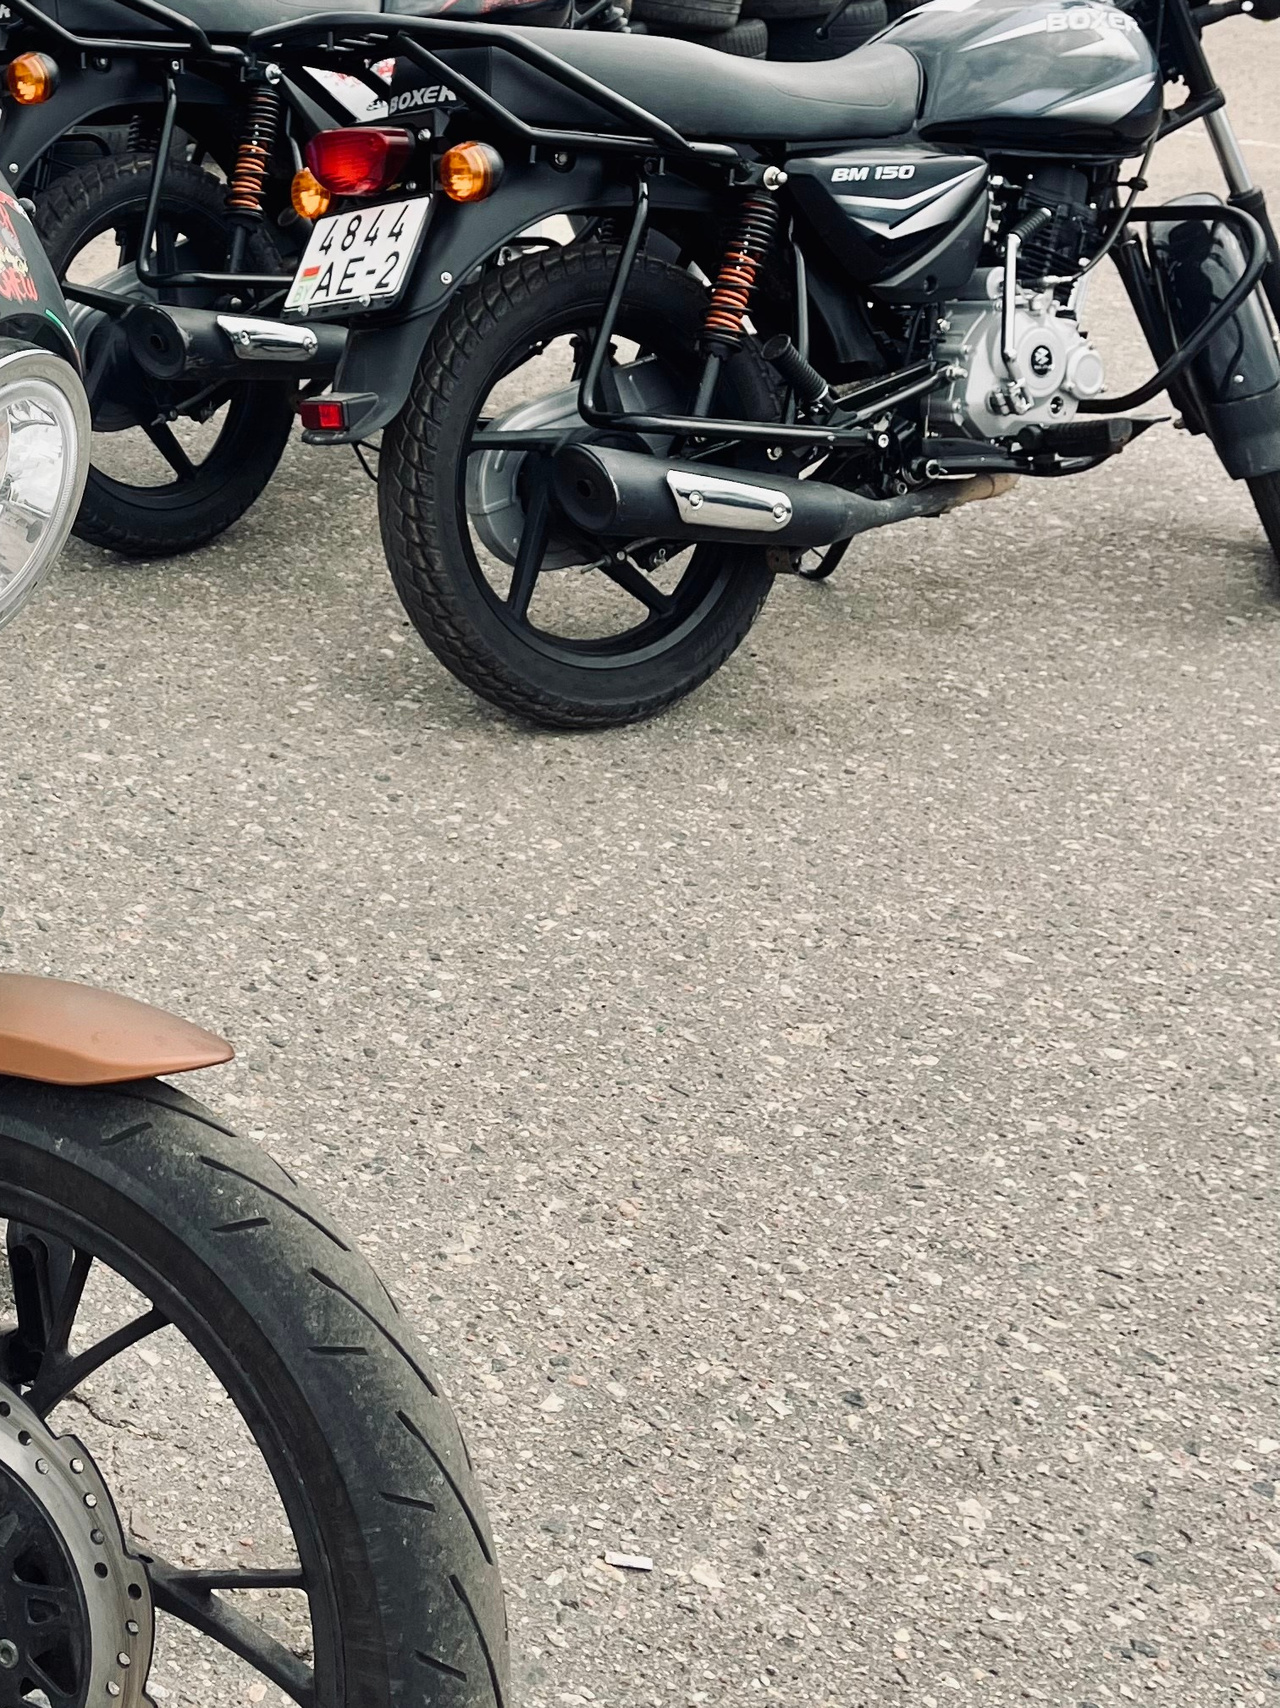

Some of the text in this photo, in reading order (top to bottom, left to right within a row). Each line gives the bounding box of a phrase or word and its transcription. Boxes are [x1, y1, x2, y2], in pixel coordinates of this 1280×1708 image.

[1046, 8, 1141, 34] BOXER
[389, 85, 457, 115] BOXER
[830, 164, 916, 183] BM 150
[319, 204, 410, 256] 4844
[310, 251, 400, 300] AE-2
